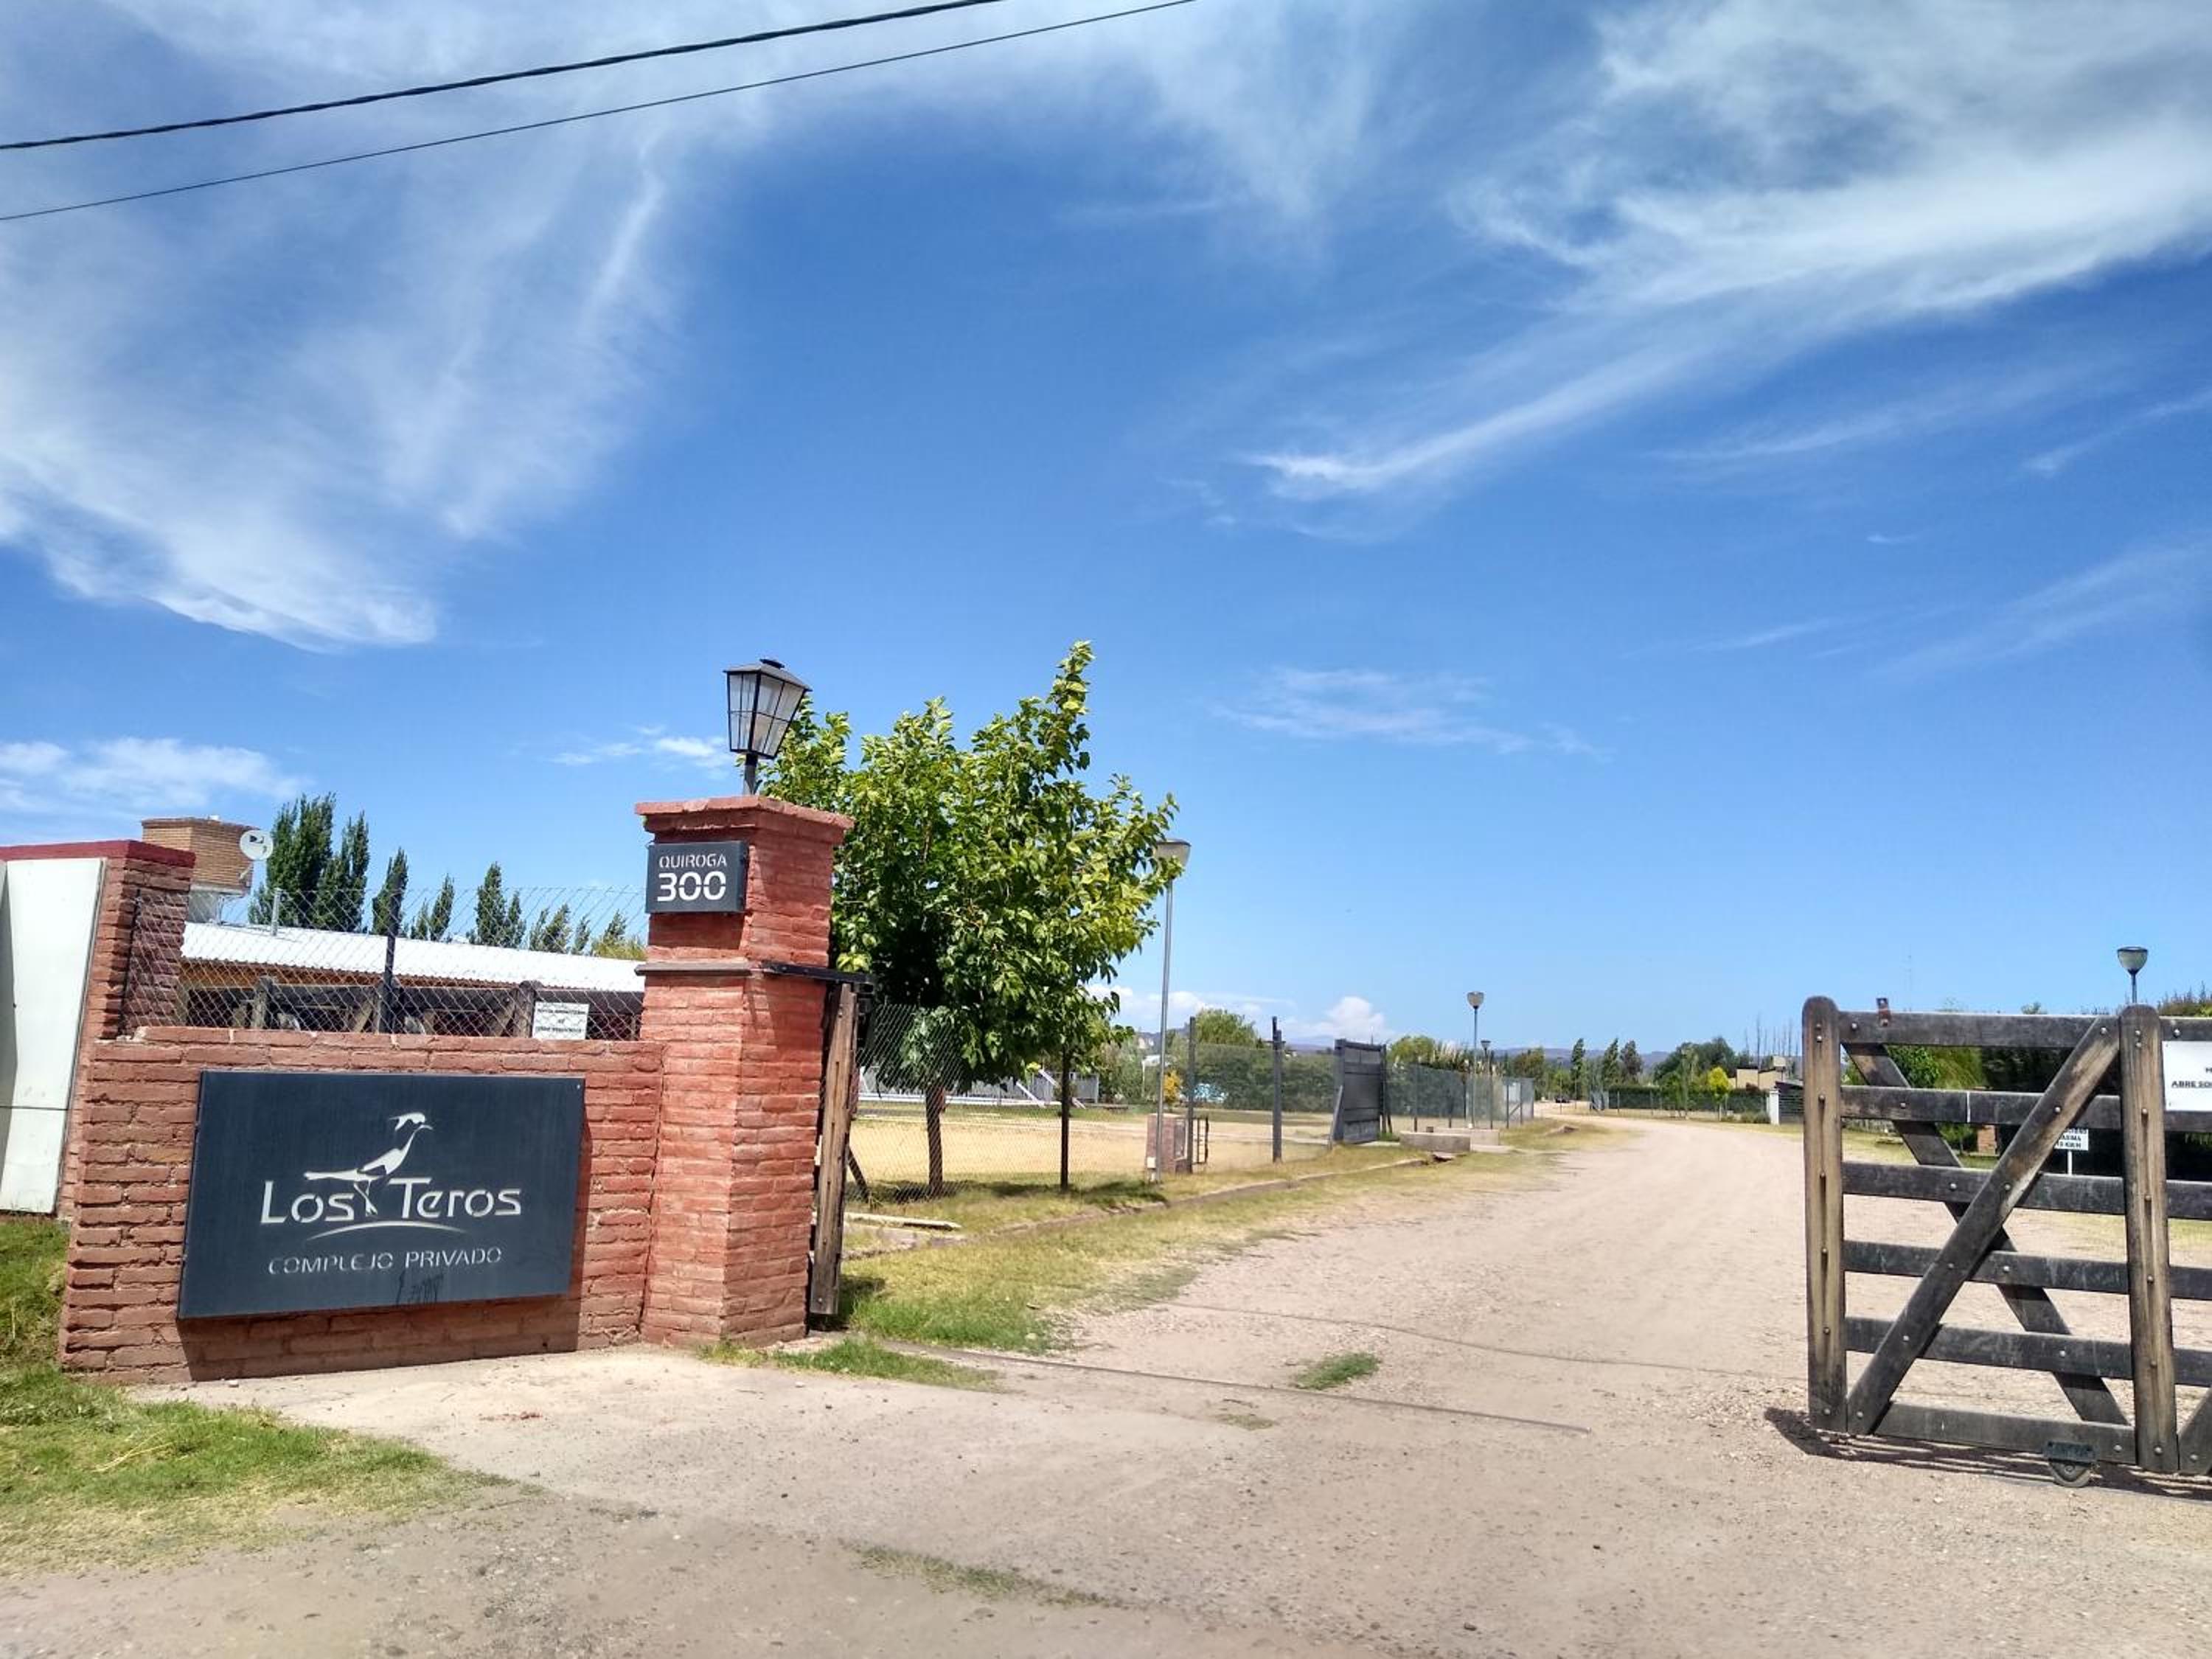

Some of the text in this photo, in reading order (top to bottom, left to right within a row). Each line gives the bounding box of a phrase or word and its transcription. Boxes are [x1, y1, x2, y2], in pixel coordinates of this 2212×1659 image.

[658, 853, 728, 869] QUIROGA
[657, 871, 726, 902] 300
[2171, 1080, 2195, 1089] ABRE
[260, 1177, 522, 1224] Los Teros
[268, 1246, 502, 1276] COMPLEJO PRIVADO
